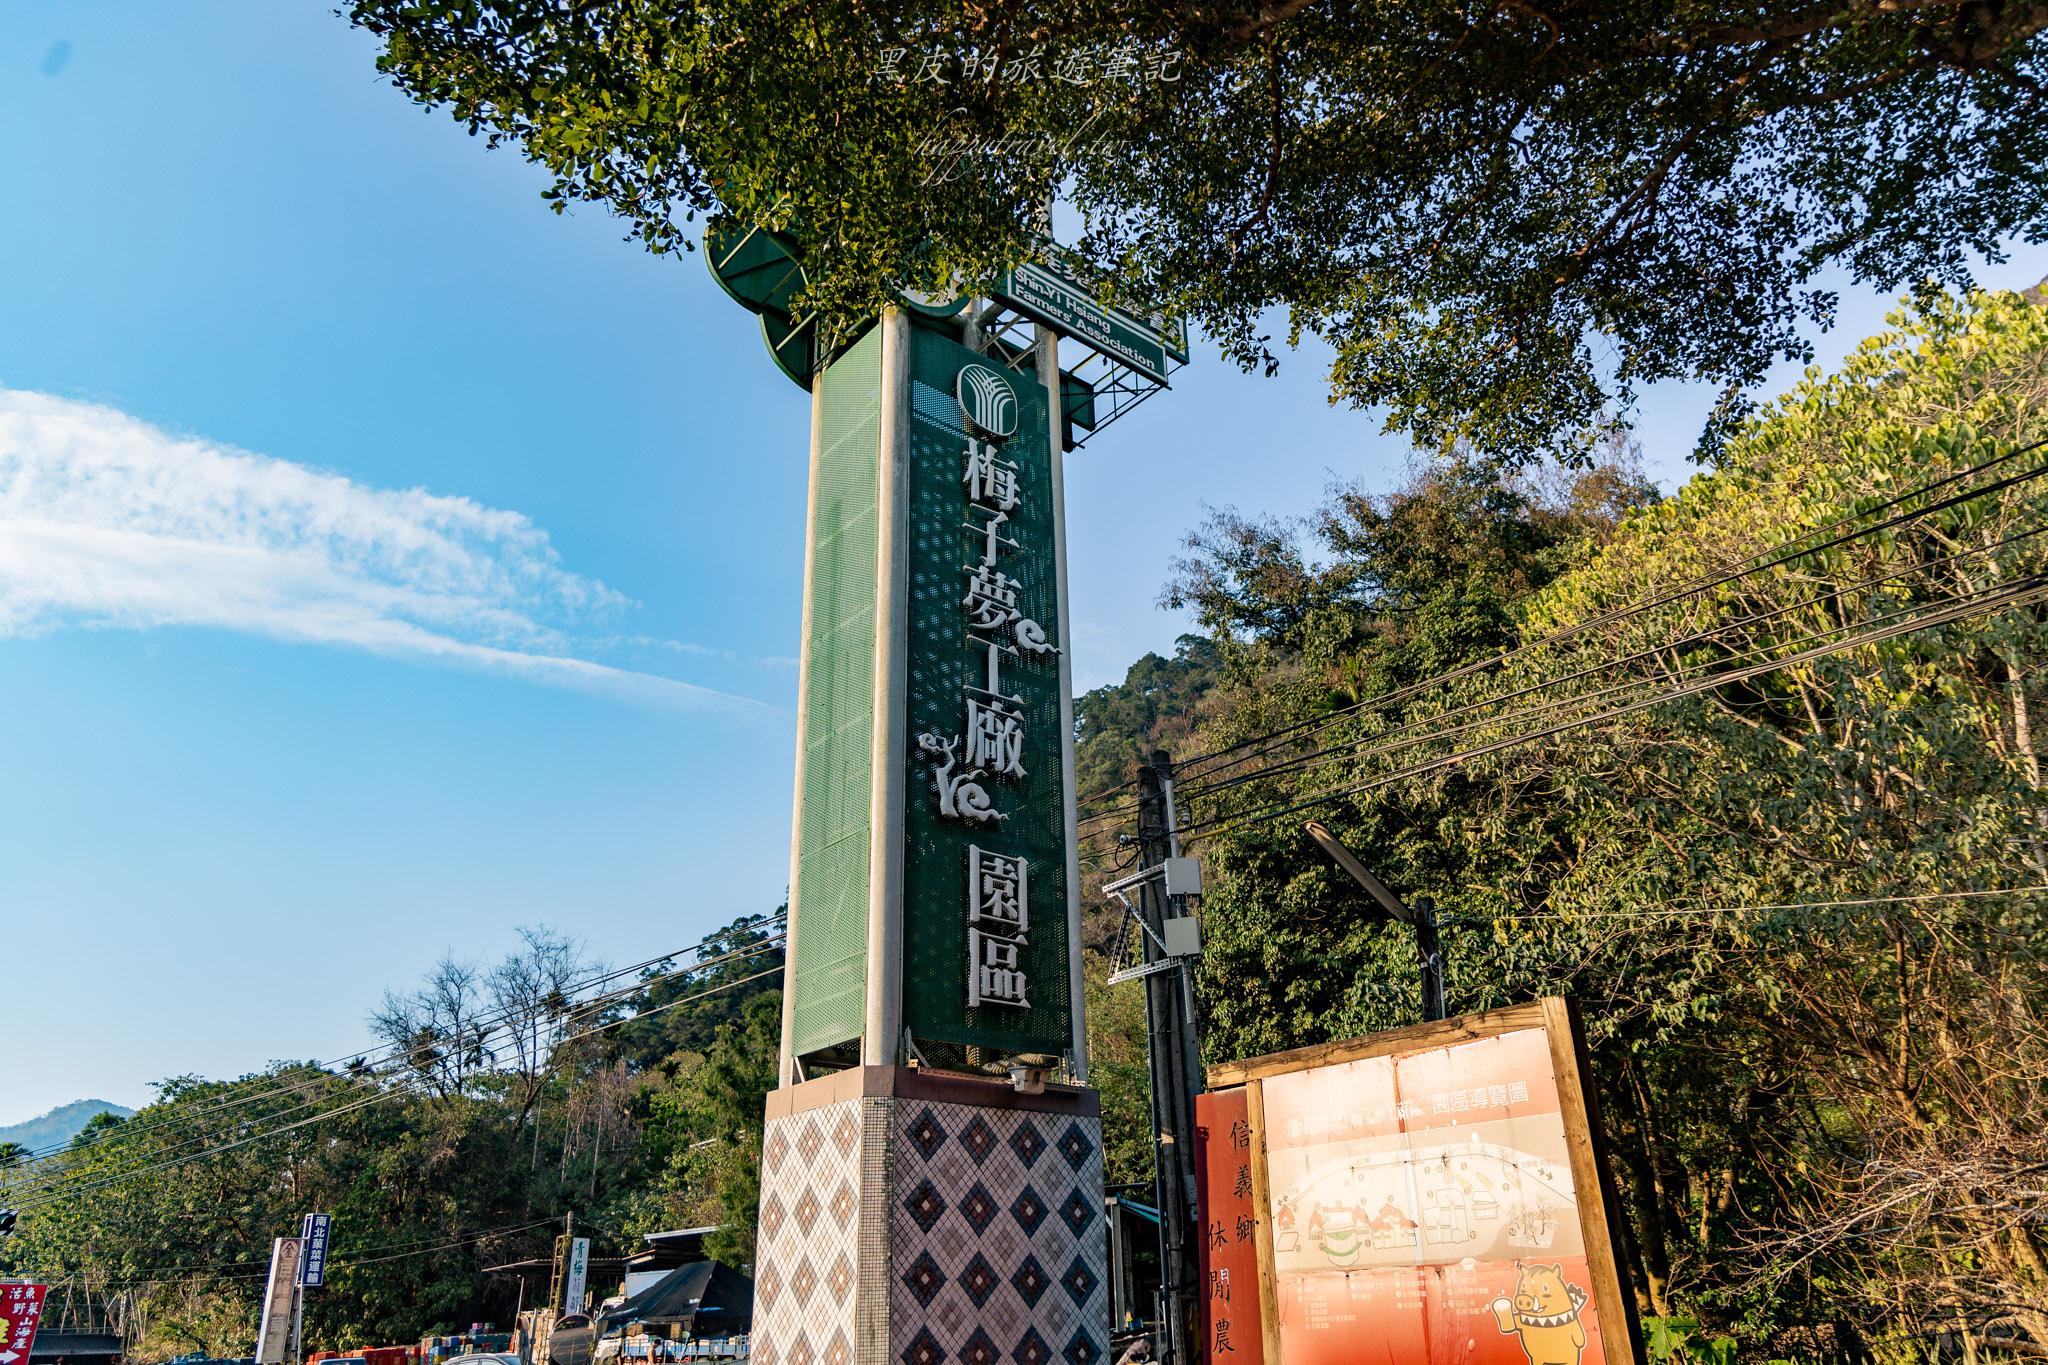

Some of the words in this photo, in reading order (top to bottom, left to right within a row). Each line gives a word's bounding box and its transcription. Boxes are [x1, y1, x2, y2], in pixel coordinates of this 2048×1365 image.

[1066, 294, 1111, 334] Hsiang
[1076, 317, 1155, 371] Association
[962, 436, 1028, 781] 梅子夢工廠
[967, 841, 1031, 1009] 園區
[1230, 1119, 1257, 1247] 信義鄉
[307, 1215, 328, 1284] 南北菓菜運輸
[9, 1286, 35, 1300] 活魚
[11, 1316, 33, 1349] 山海產
